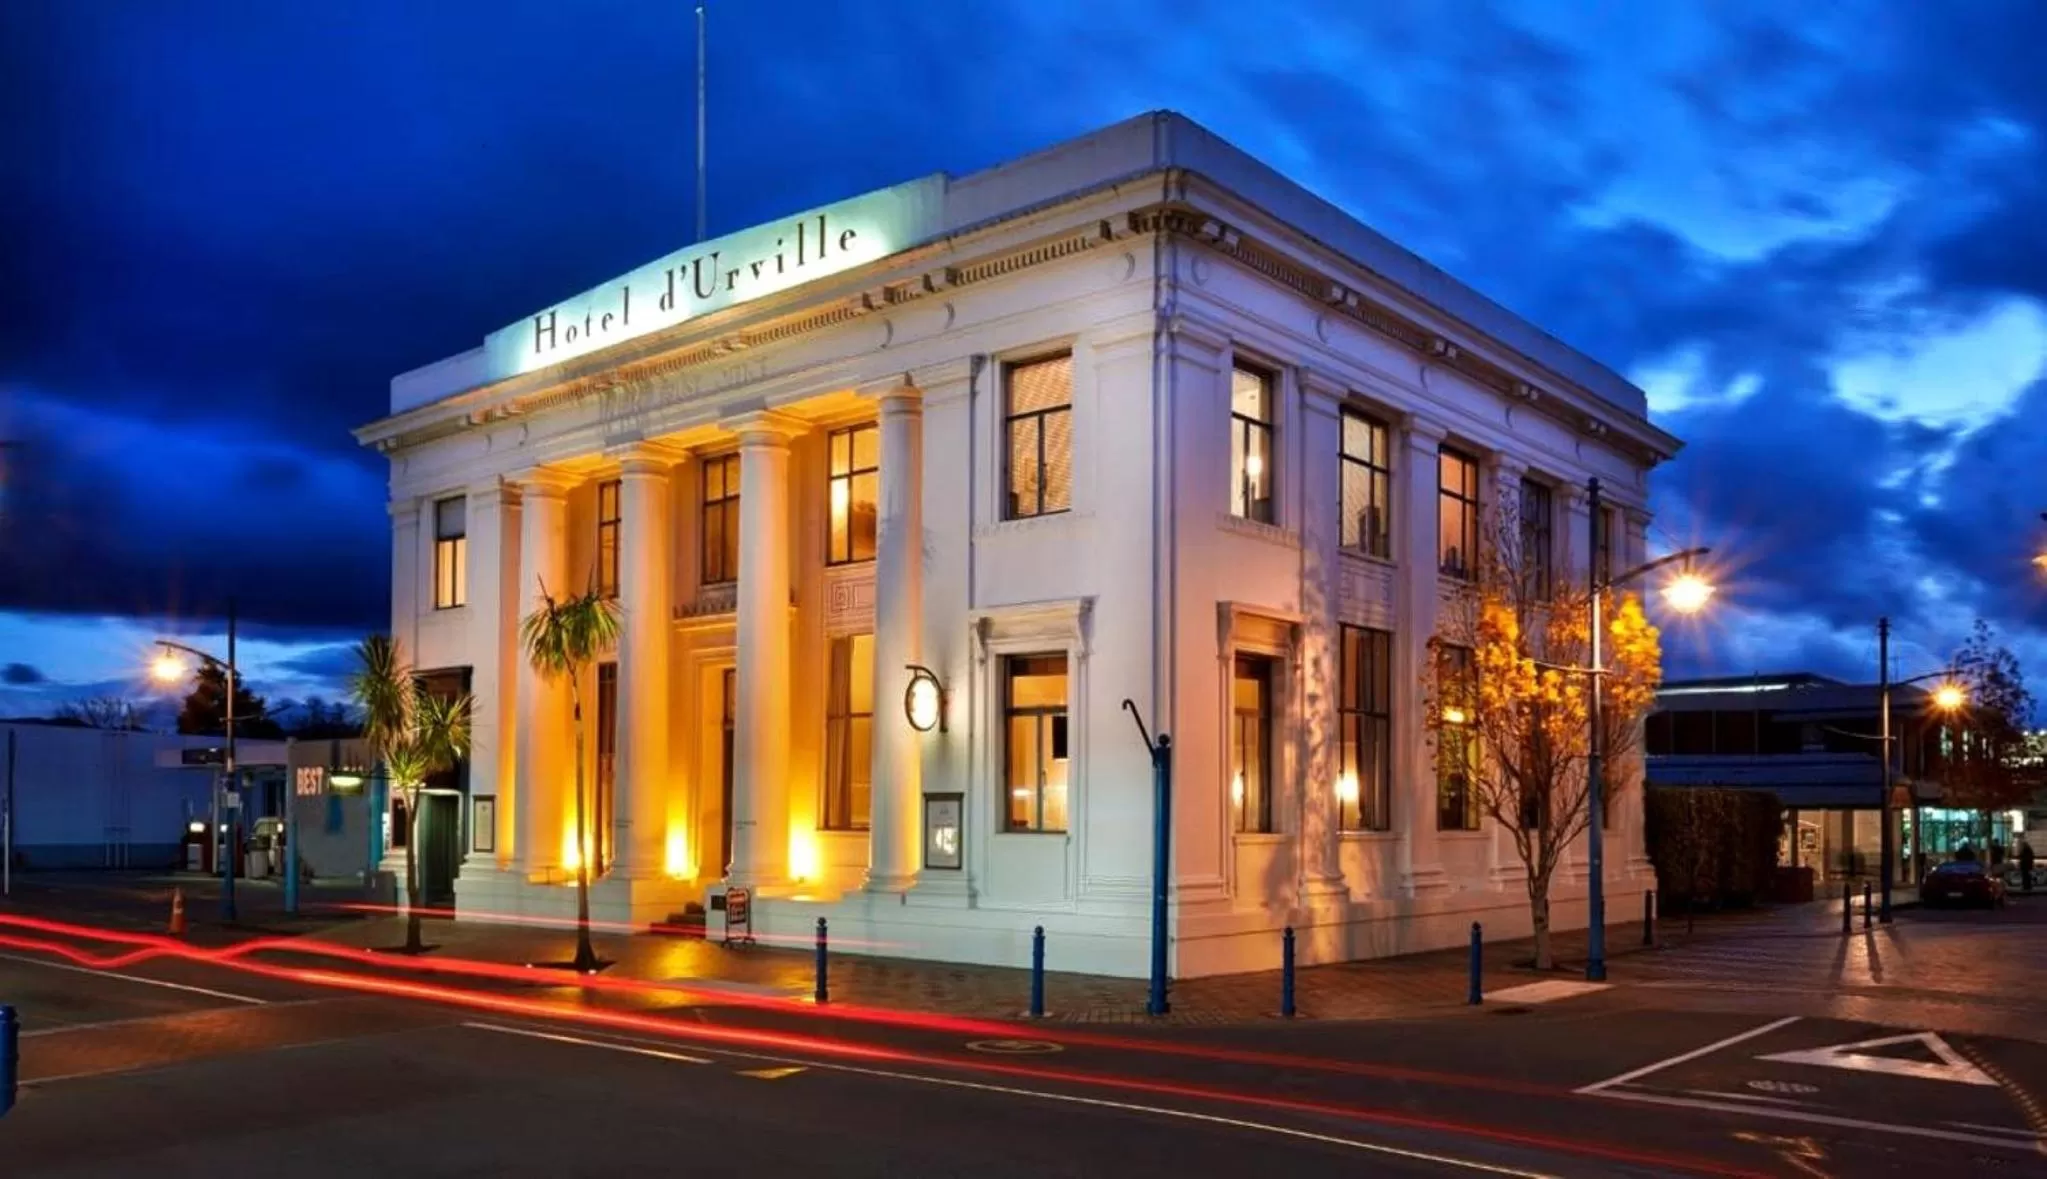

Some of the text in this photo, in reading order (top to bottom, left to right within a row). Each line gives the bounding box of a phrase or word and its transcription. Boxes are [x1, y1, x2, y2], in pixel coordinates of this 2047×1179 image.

[533, 214, 857, 353] Hotel d'Urville
[297, 767, 324, 795] BEST
